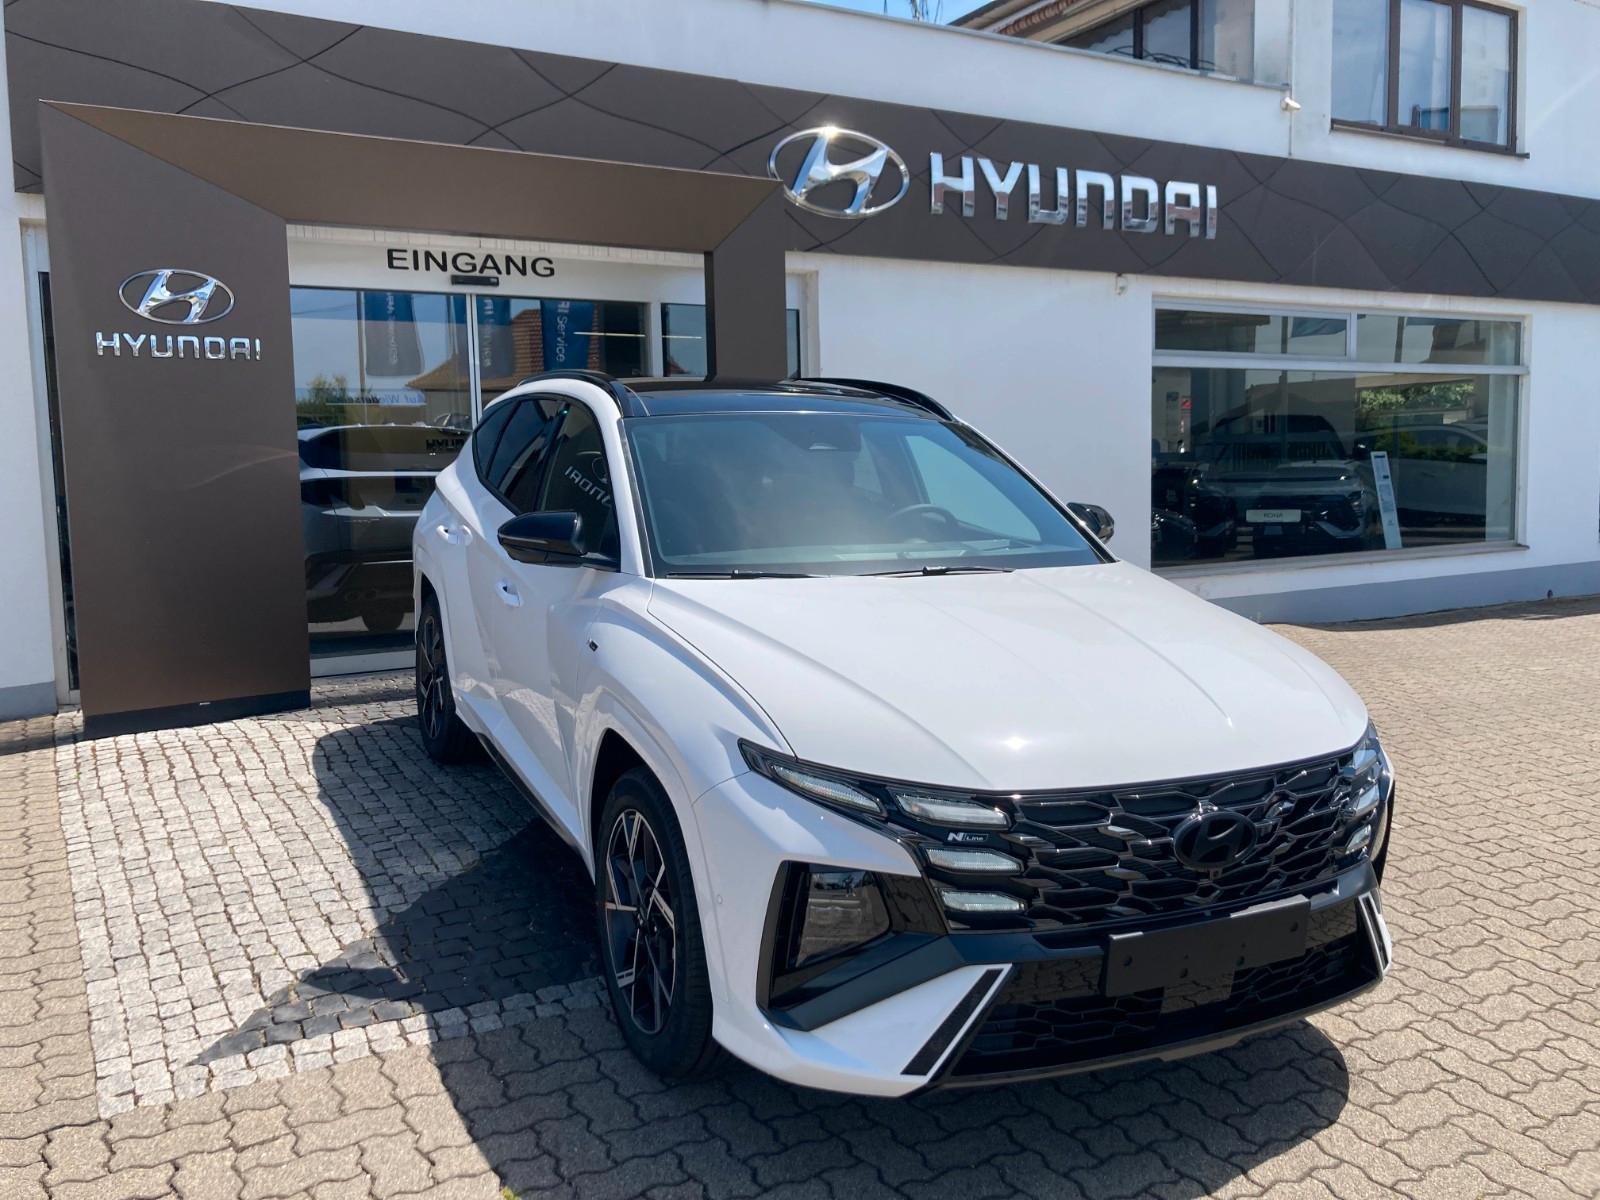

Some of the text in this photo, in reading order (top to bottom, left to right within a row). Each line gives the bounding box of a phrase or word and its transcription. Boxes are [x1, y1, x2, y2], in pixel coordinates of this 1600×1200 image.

[929, 151, 1217, 239] HYUNDAI
[387, 248, 556, 277] EINGANG
[95, 331, 261, 361] HYUNDAI
[556, 315, 568, 362] Service
[426, 439, 466, 450] HYUN
[947, 831, 965, 842] N
